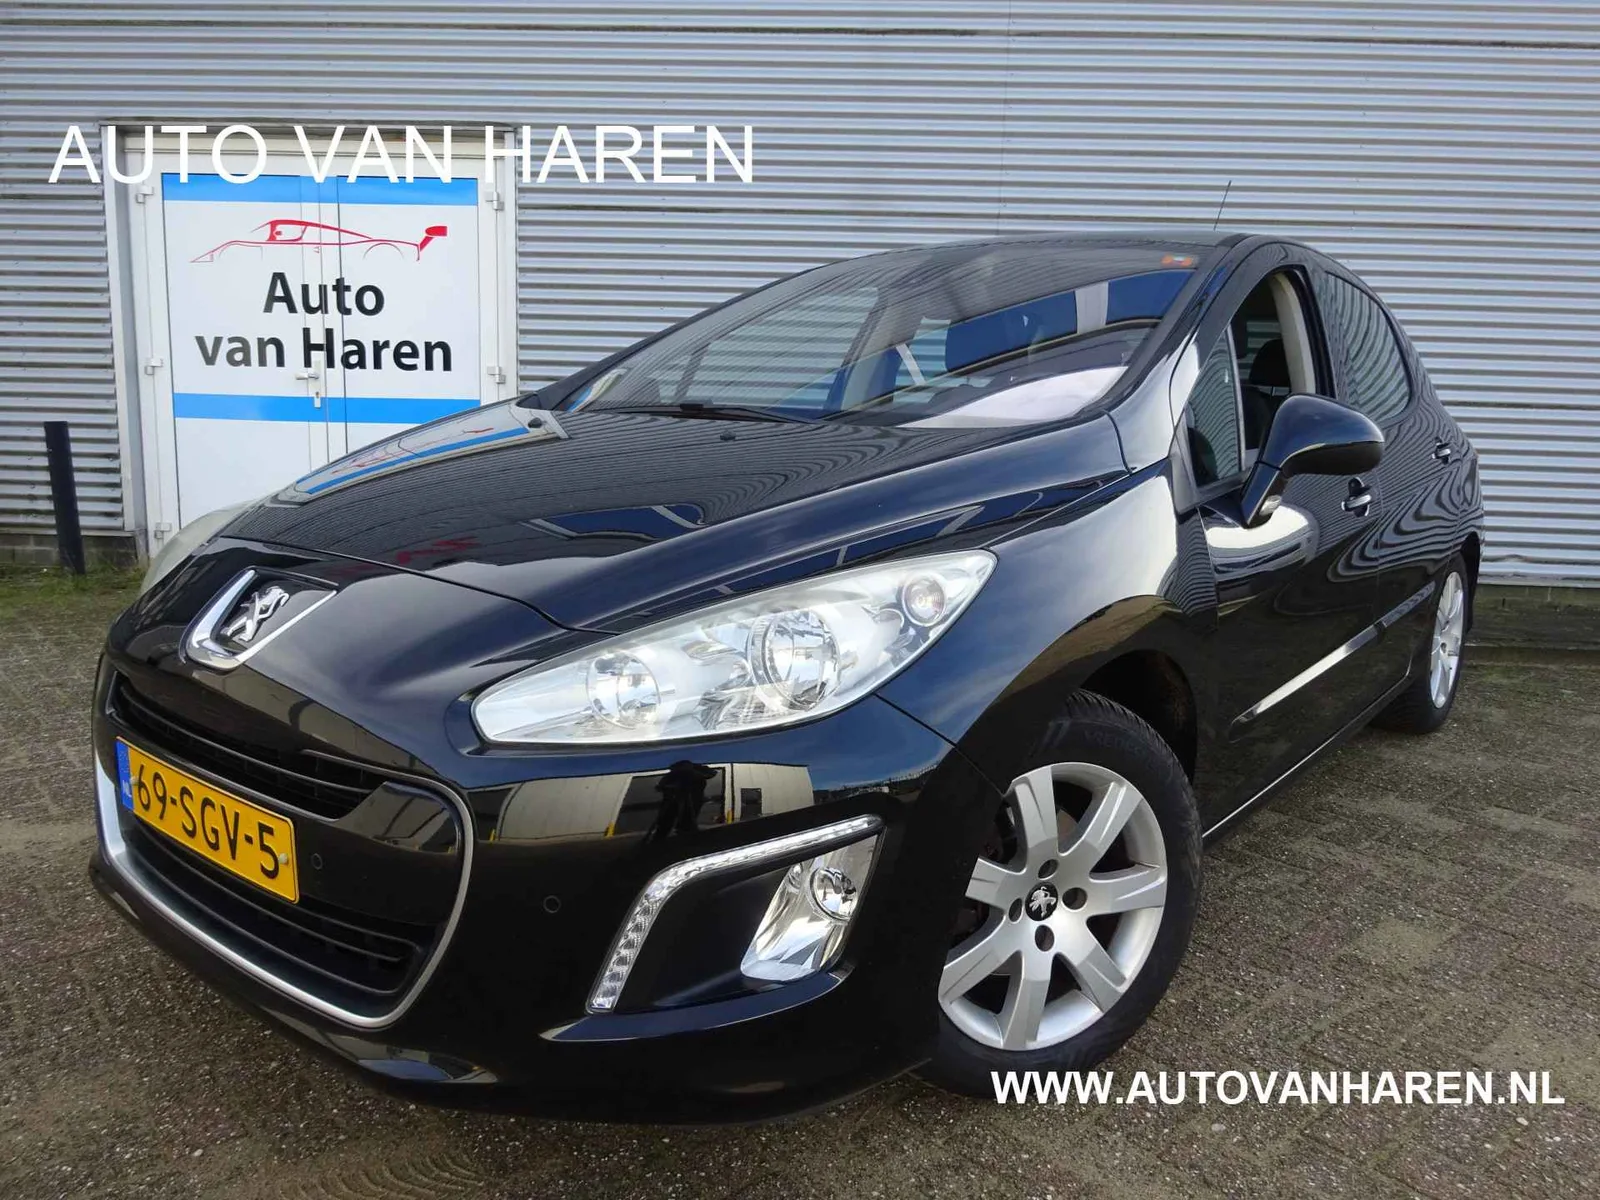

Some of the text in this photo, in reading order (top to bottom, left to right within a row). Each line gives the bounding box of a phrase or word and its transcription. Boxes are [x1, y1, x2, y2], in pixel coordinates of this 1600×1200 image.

[263, 272, 385, 316] Auto
[195, 327, 452, 371] van Haren
[138, 765, 280, 879] 69-SGV-5
